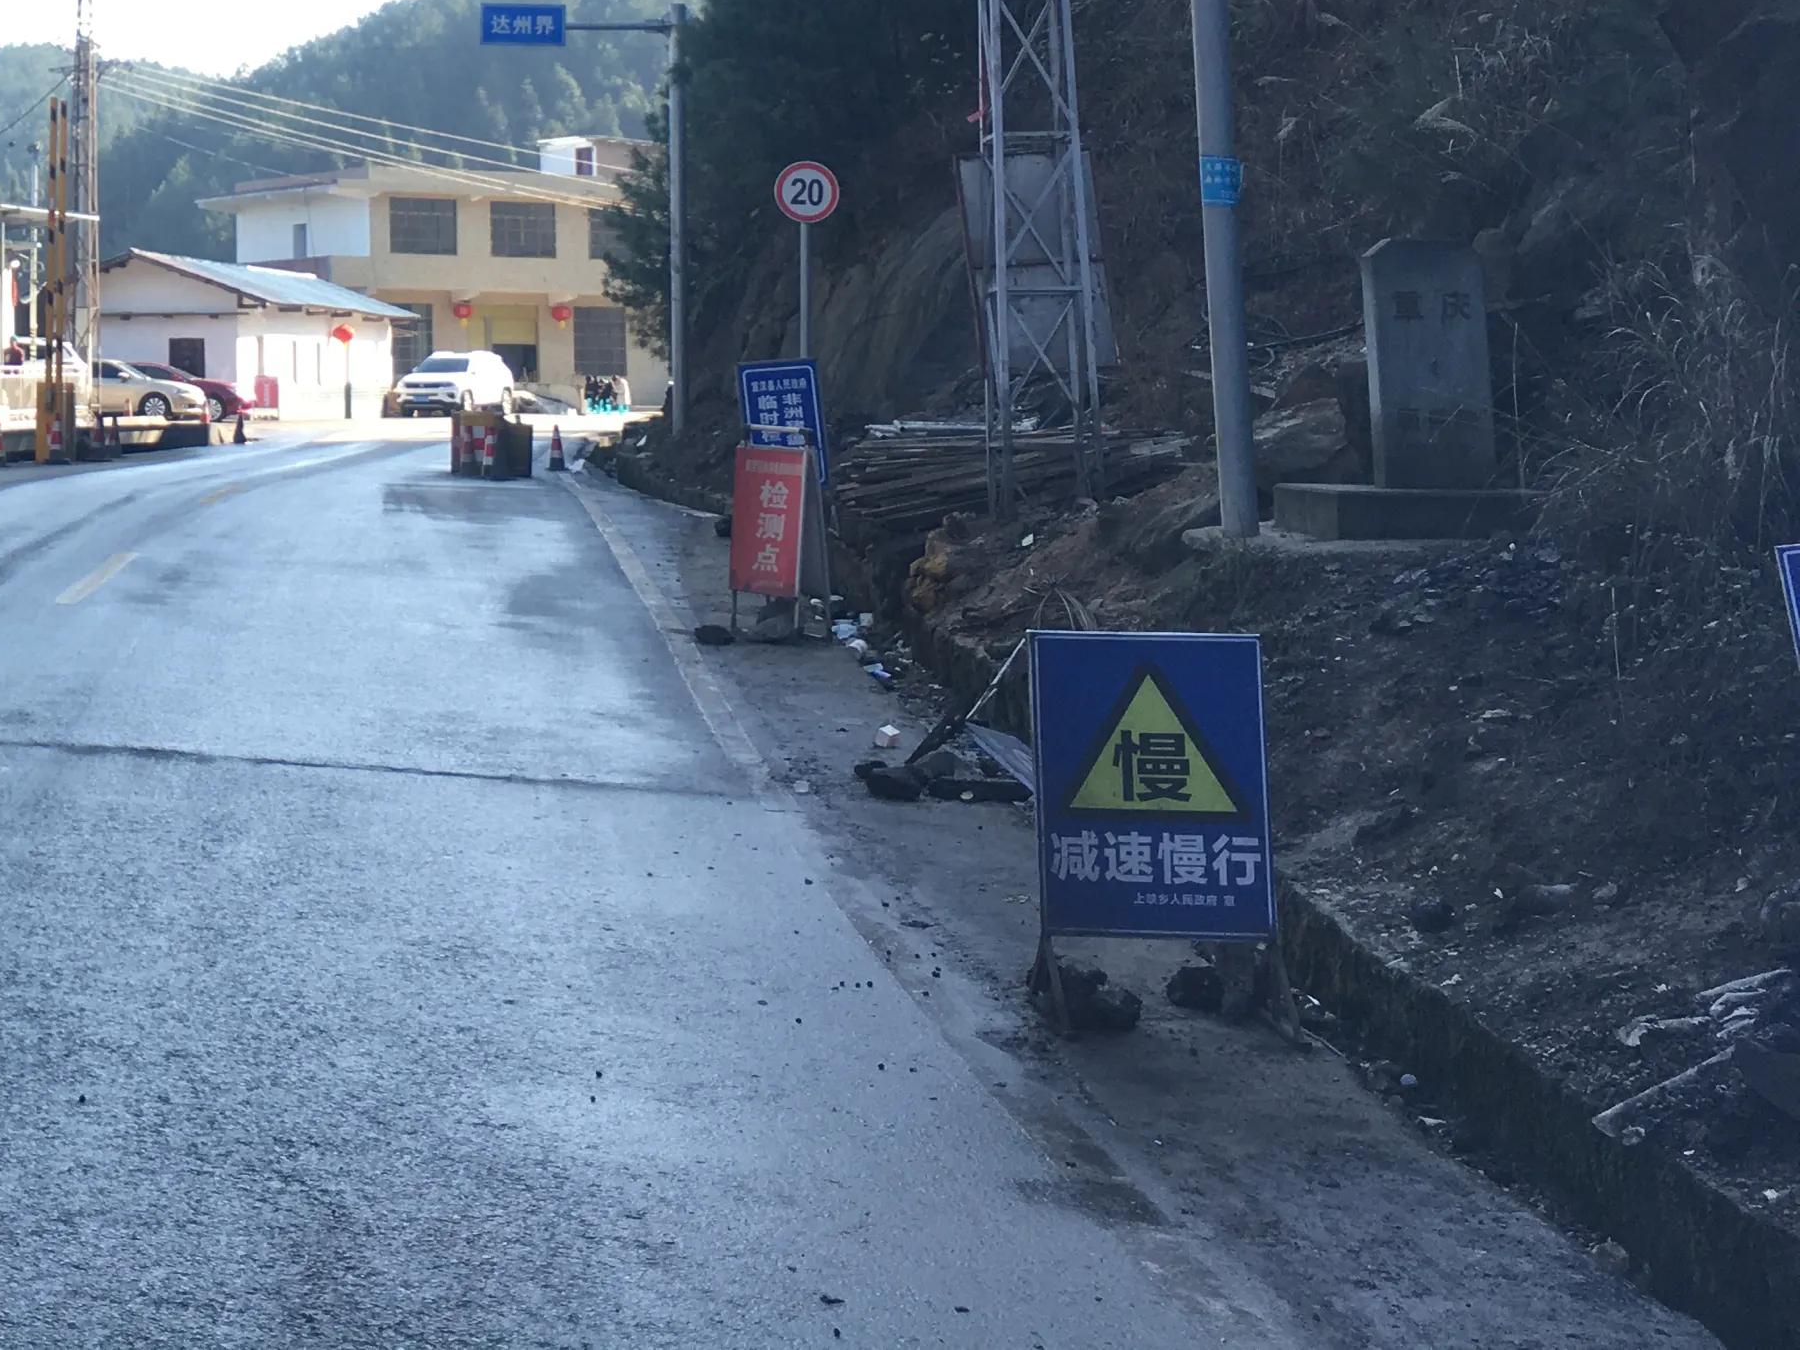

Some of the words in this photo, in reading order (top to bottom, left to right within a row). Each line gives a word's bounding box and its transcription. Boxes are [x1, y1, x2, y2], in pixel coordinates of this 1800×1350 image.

[491, 14, 555, 35] 达州界
[791, 178, 824, 206] 20
[752, 479, 789, 572] 检测点
[1112, 730, 1192, 802] 慢
[1050, 830, 1261, 886] 减速慢行
